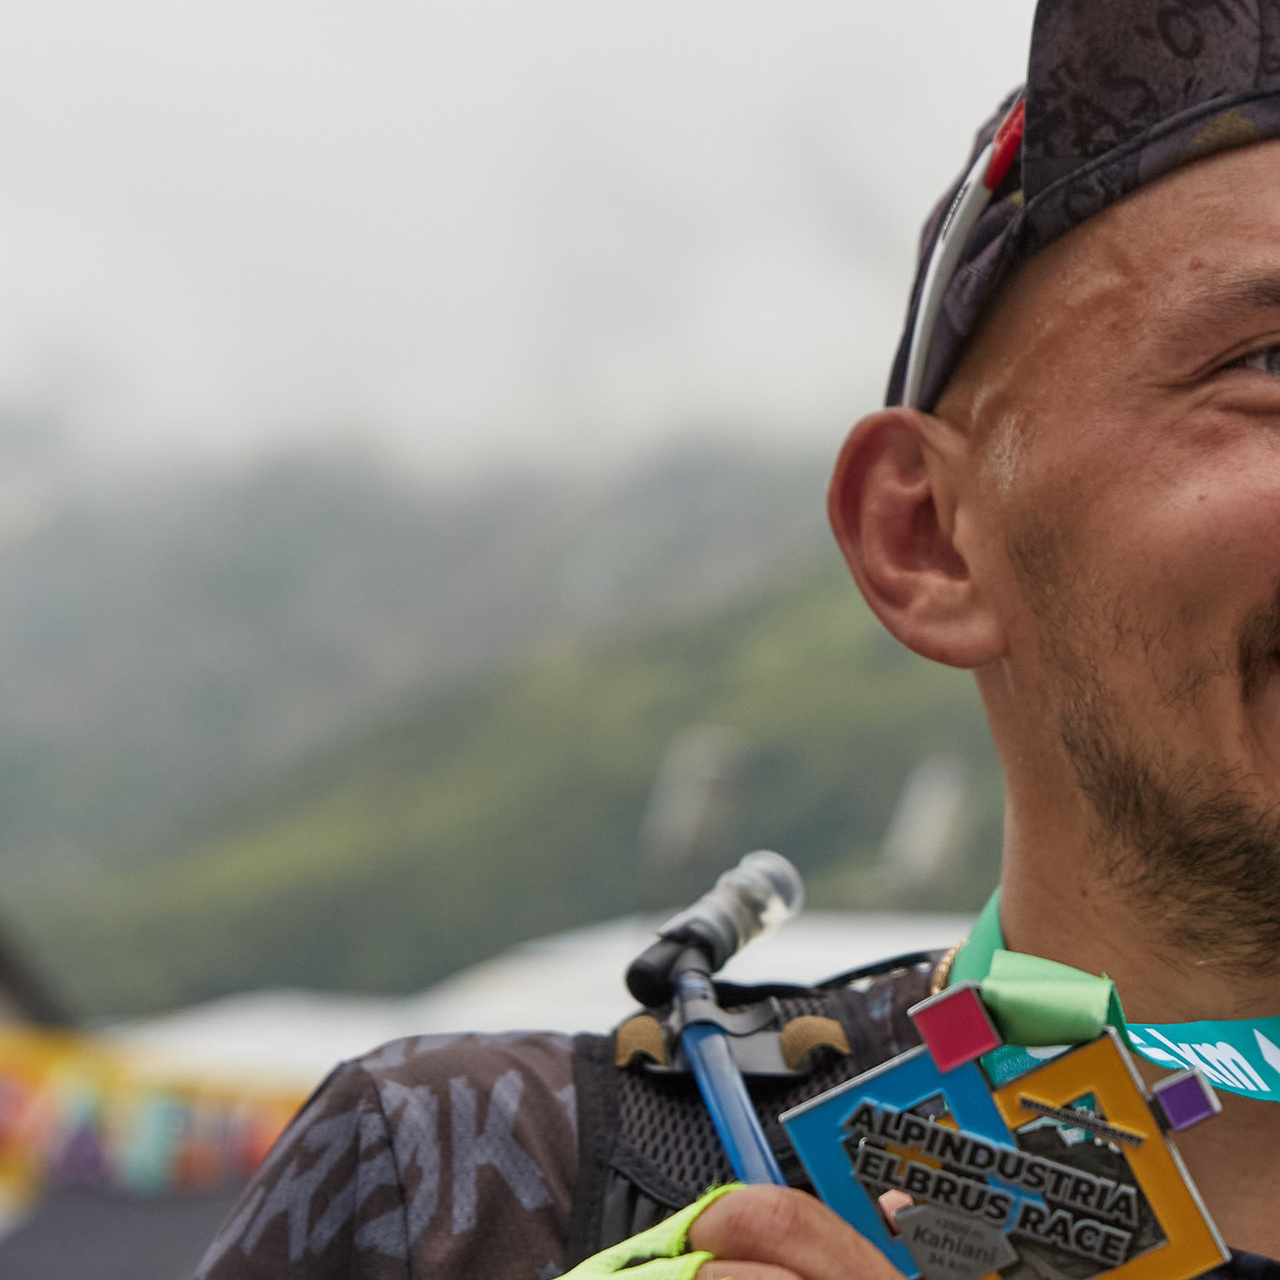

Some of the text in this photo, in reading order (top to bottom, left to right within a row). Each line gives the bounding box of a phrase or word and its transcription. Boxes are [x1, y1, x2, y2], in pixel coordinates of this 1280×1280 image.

[850, 1102, 1138, 1222] ALPINDUSTRIA
[858, 1149, 1132, 1262] ELBRUS RACE
